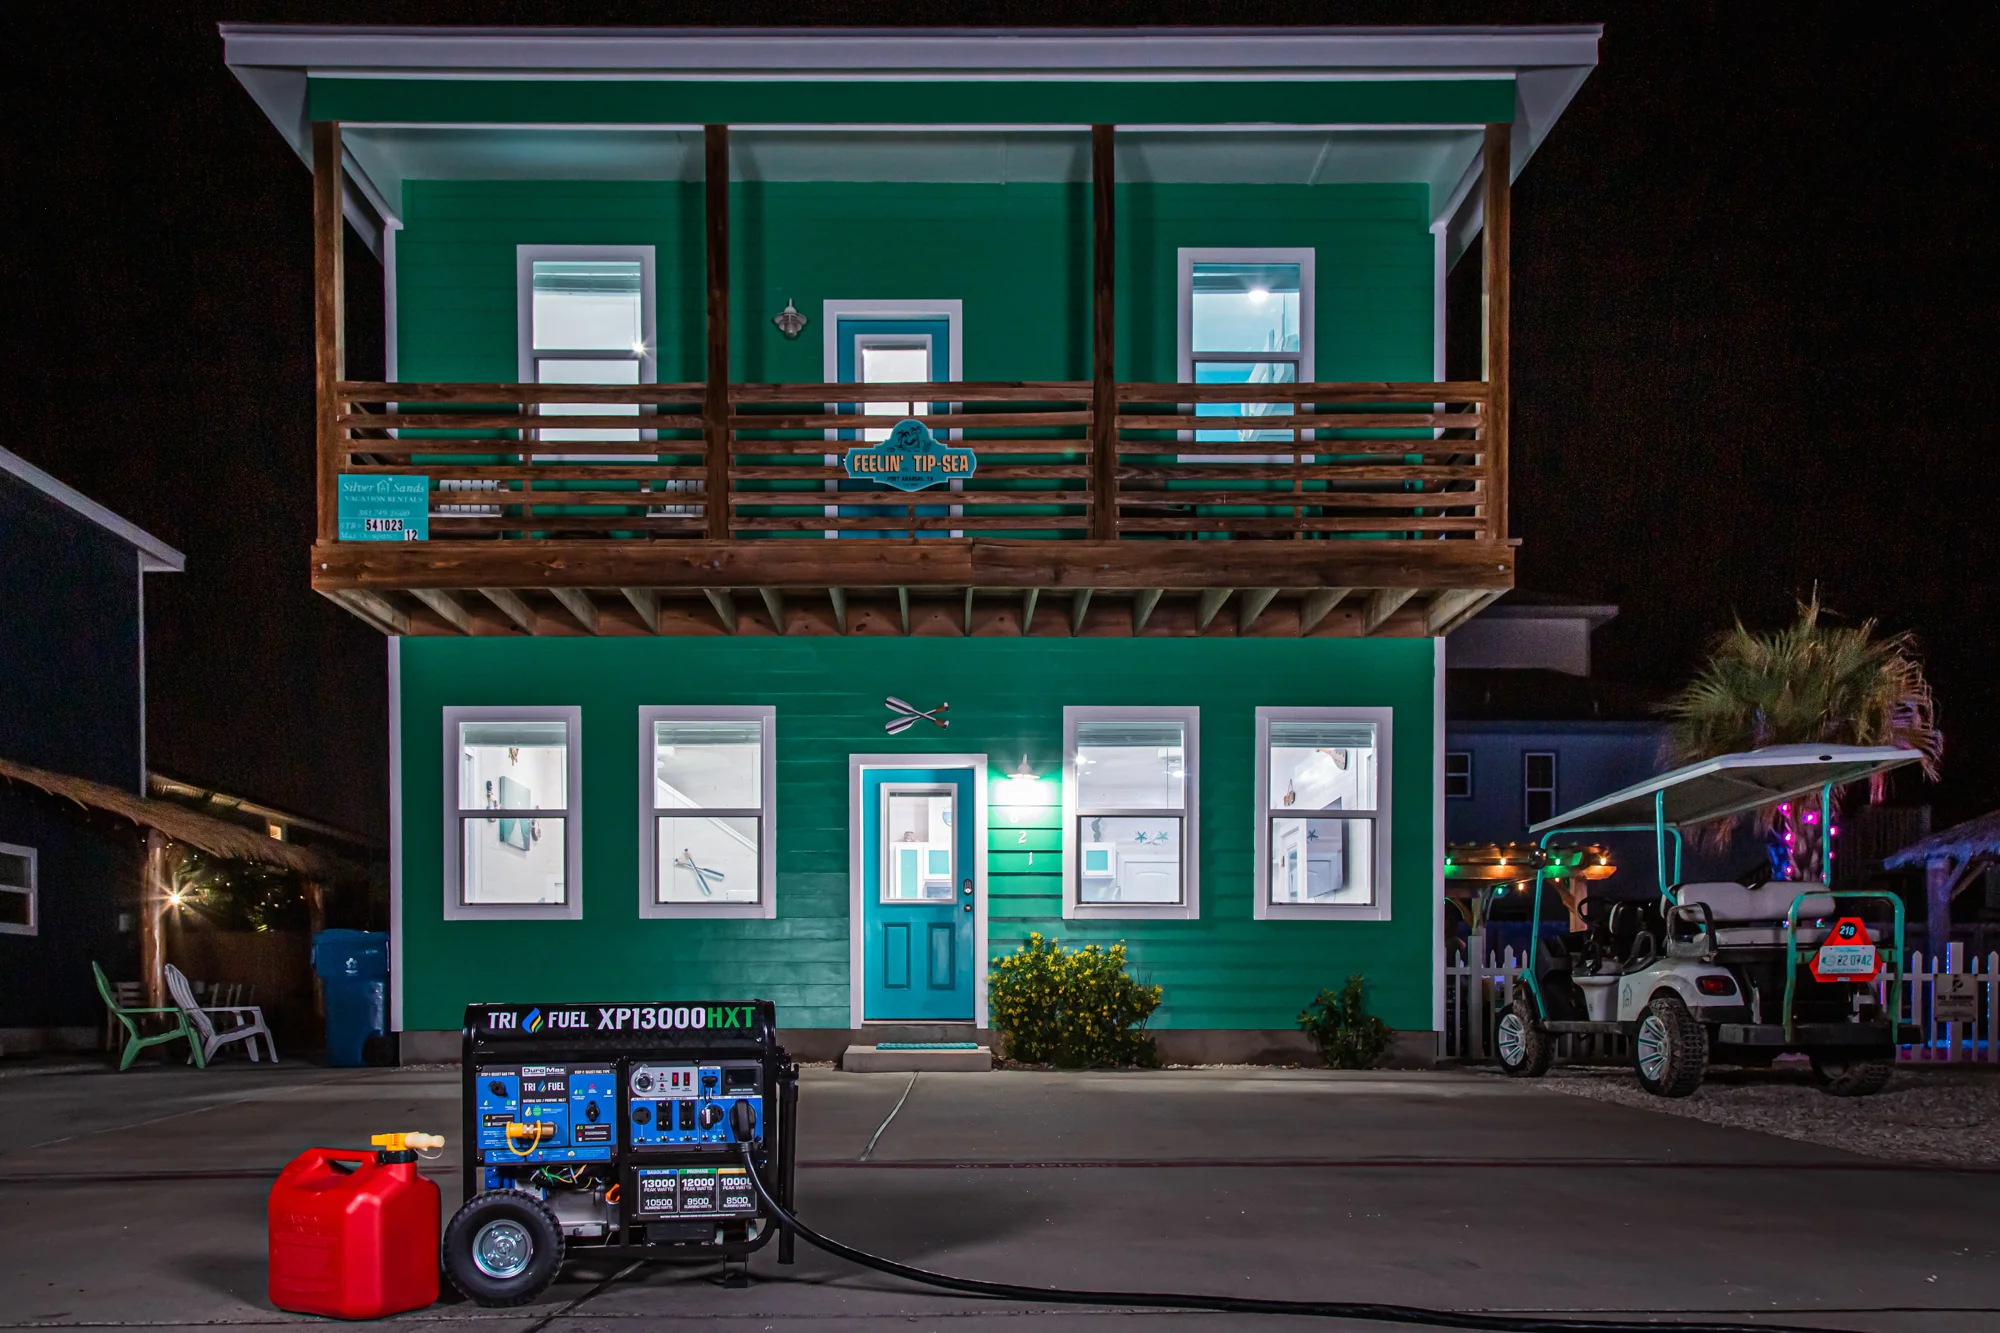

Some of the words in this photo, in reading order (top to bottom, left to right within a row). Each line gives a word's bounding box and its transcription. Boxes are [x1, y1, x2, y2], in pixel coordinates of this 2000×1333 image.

[853, 455, 904, 472] FEELIN'
[913, 455, 969, 472] TIP-SEA
[343, 482, 374, 492] Silver
[393, 483, 425, 493] Sands
[366, 519, 404, 531] 541023
[406, 530, 418, 541] 12
[488, 1012, 517, 1029] TRI
[548, 1011, 589, 1028] FUEL
[524, 1083, 535, 1091] TRI
[548, 1082, 565, 1090] FUEL
[641, 1179, 676, 1188] 13000
[681, 1178, 715, 1187] 12000
[645, 1198, 672, 1206] 10500
[687, 1197, 709, 1205] 9500
[726, 1196, 748, 1204] 8500
